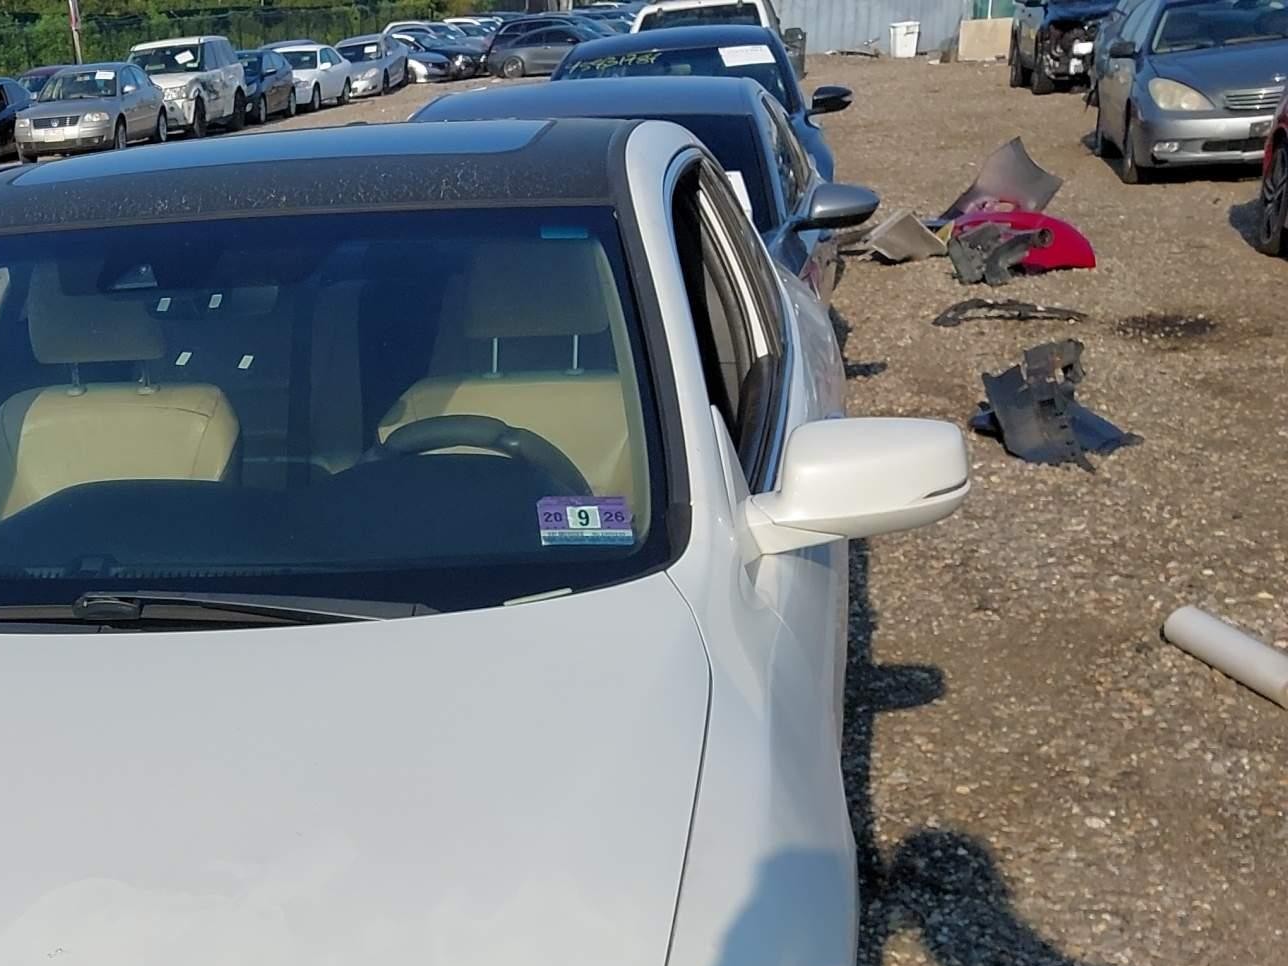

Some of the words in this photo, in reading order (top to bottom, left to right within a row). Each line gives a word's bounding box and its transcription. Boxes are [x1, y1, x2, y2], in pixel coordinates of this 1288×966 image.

[543, 512, 563, 522] 20
[577, 509, 590, 527] 9
[603, 511, 625, 522] 26
